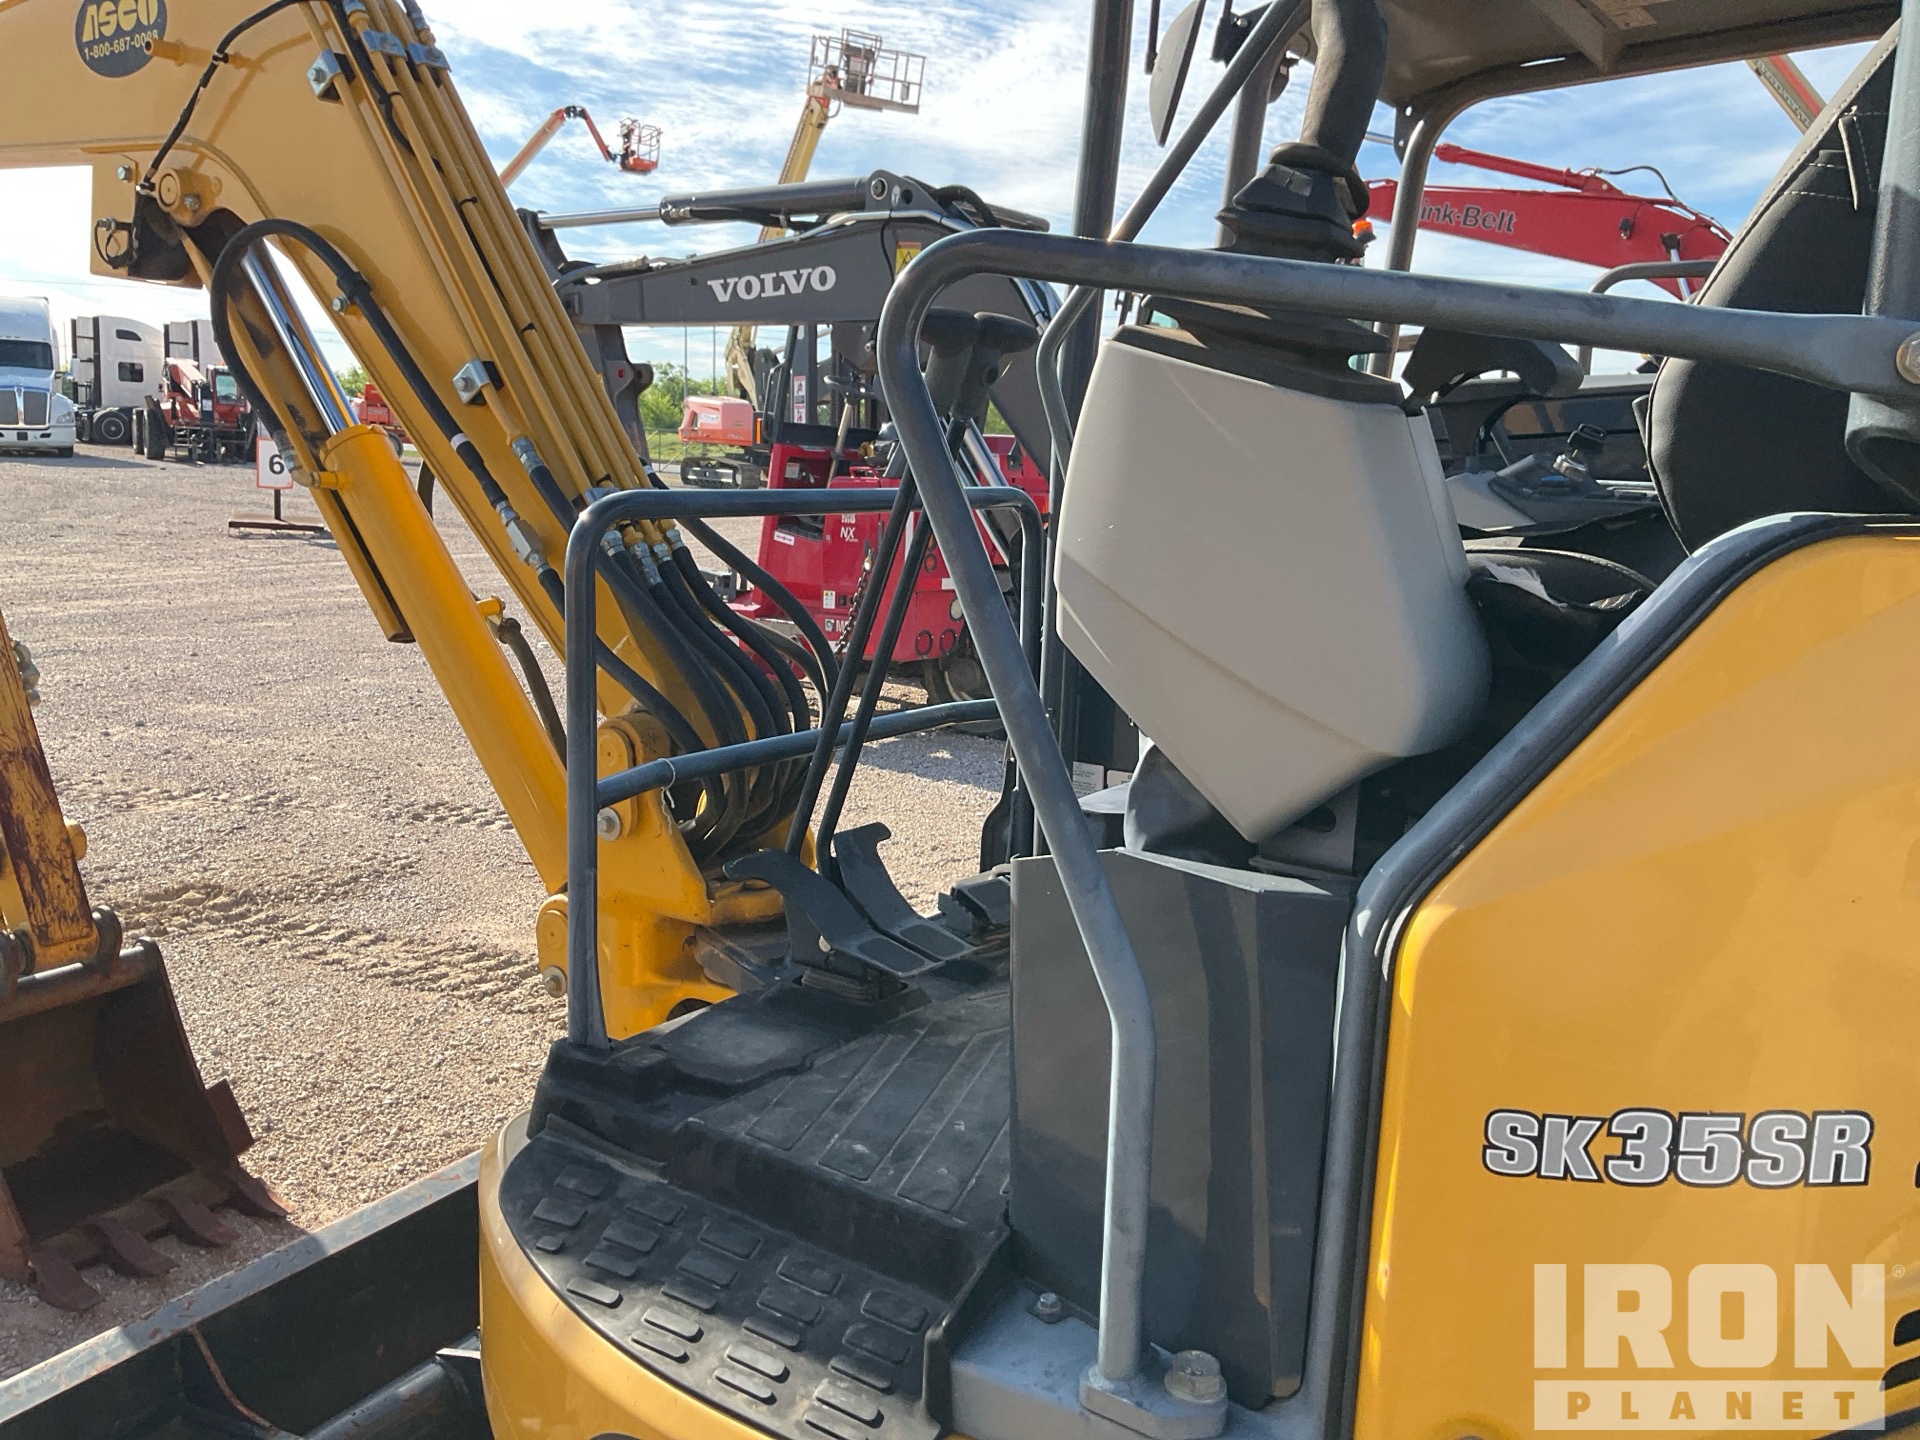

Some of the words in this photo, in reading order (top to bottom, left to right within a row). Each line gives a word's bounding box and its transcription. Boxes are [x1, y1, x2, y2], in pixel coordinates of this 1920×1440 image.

[82, 0, 158, 42] ASCO
[1420, 200, 1515, 233] ink-Belt
[707, 266, 836, 302] VOLVO
[269, 454, 285, 475] 6
[840, 526, 856, 541] NX
[1484, 1107, 1873, 1188] SK35SR
